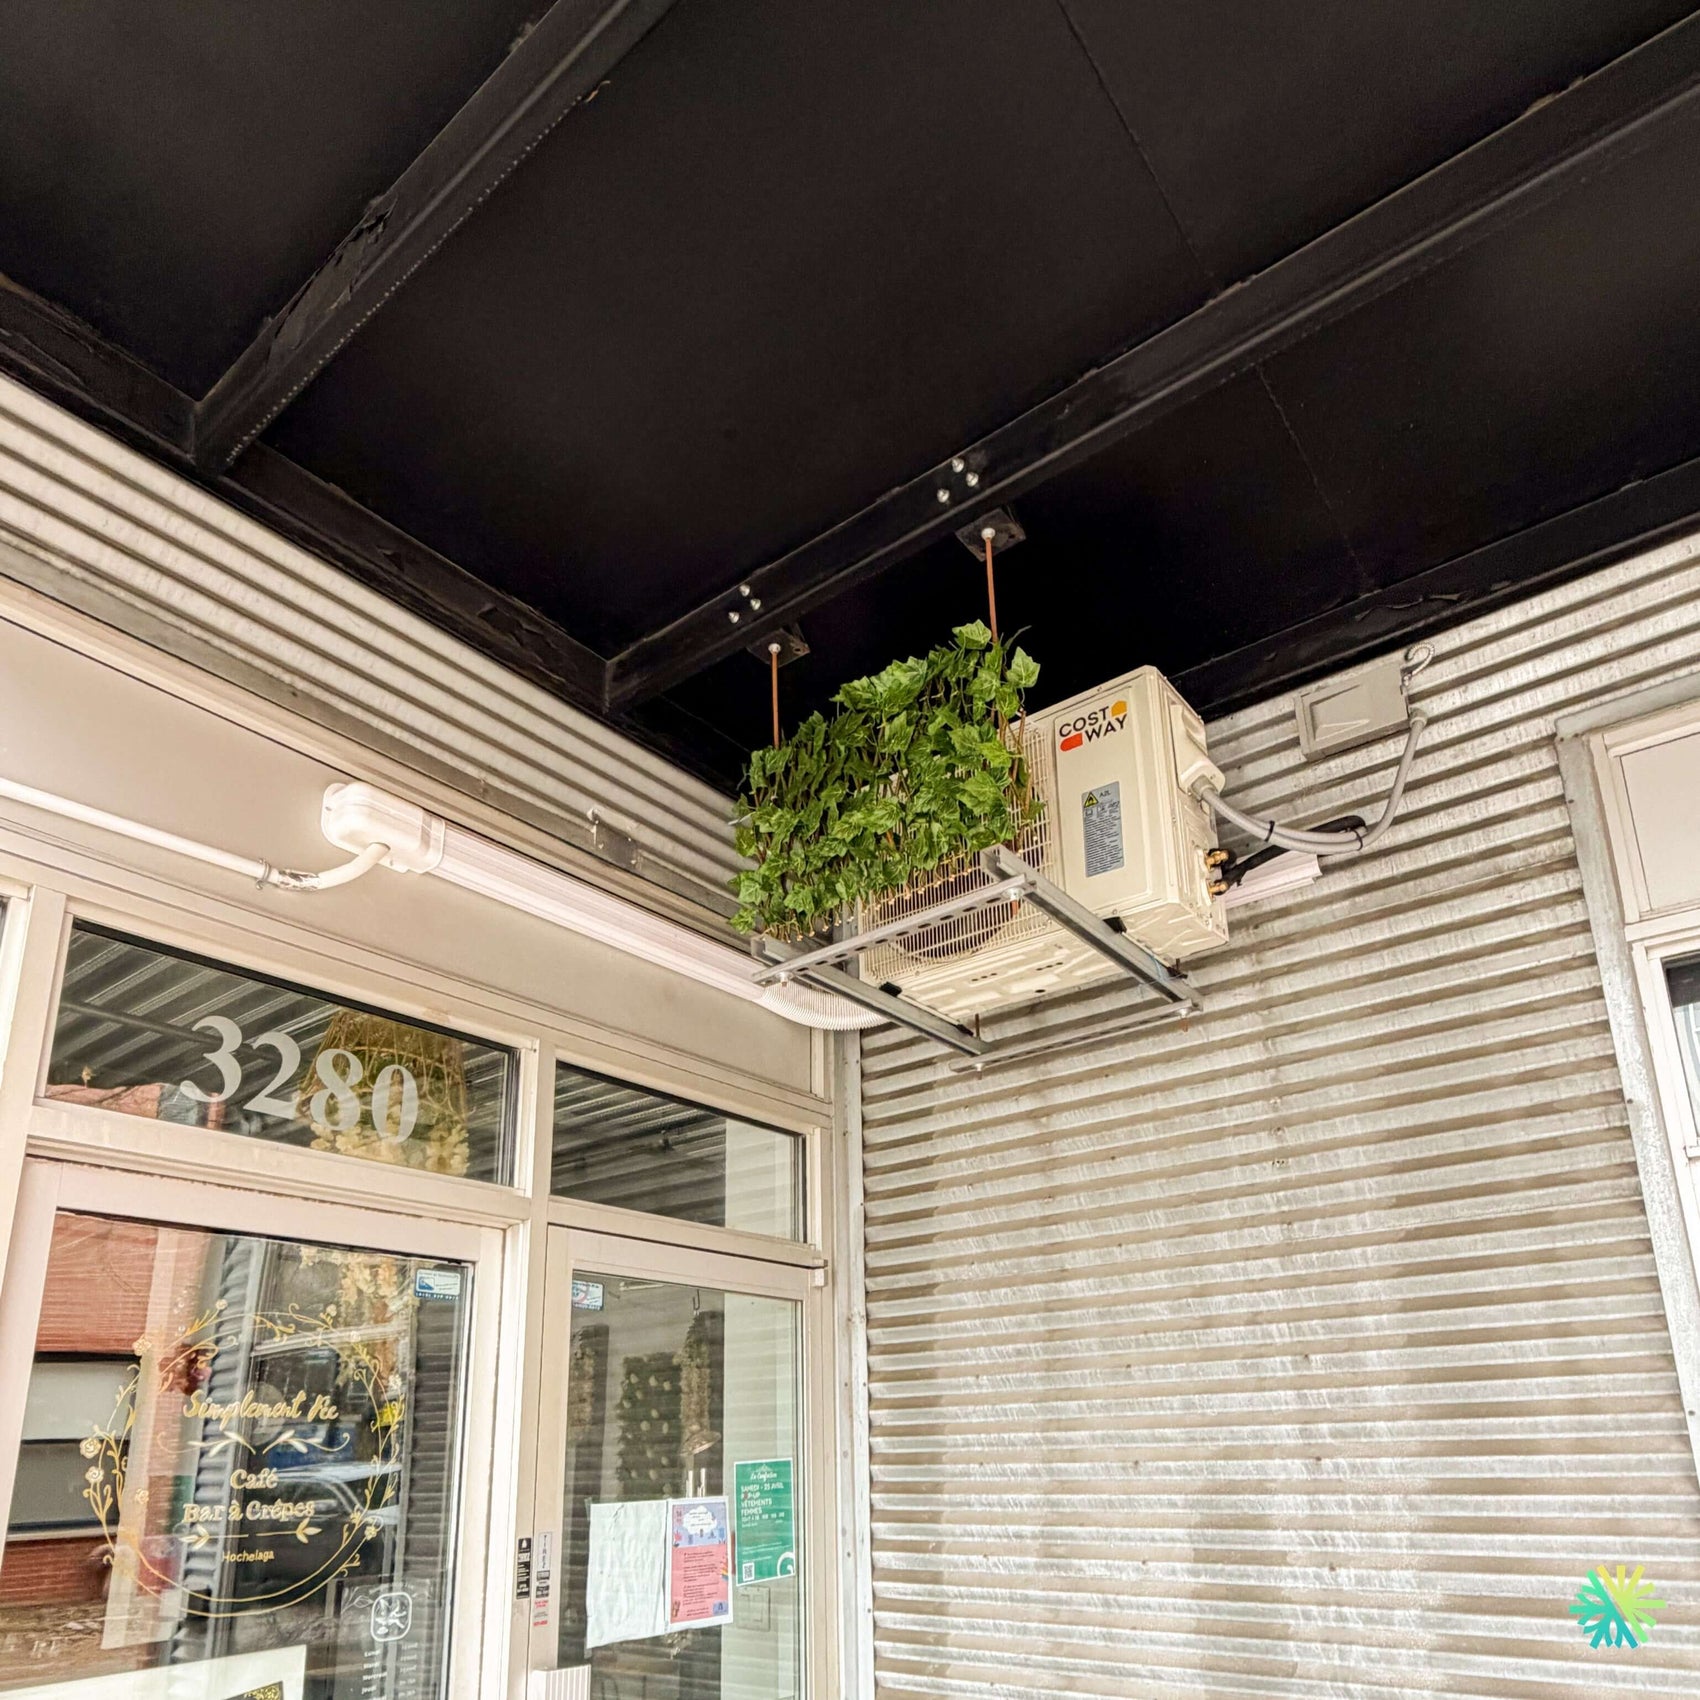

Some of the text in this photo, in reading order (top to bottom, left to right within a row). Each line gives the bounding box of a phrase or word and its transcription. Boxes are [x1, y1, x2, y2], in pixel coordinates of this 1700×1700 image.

[1059, 706, 1109, 737] COST
[1085, 713, 1127, 742] WAY
[179, 1015, 420, 1143] 3280
[183, 1389, 307, 1431] Simplement
[230, 1468, 279, 1489] Café
[183, 1499, 315, 1523] Bar à Crêpes
[222, 1549, 275, 1563] Hochelaga
